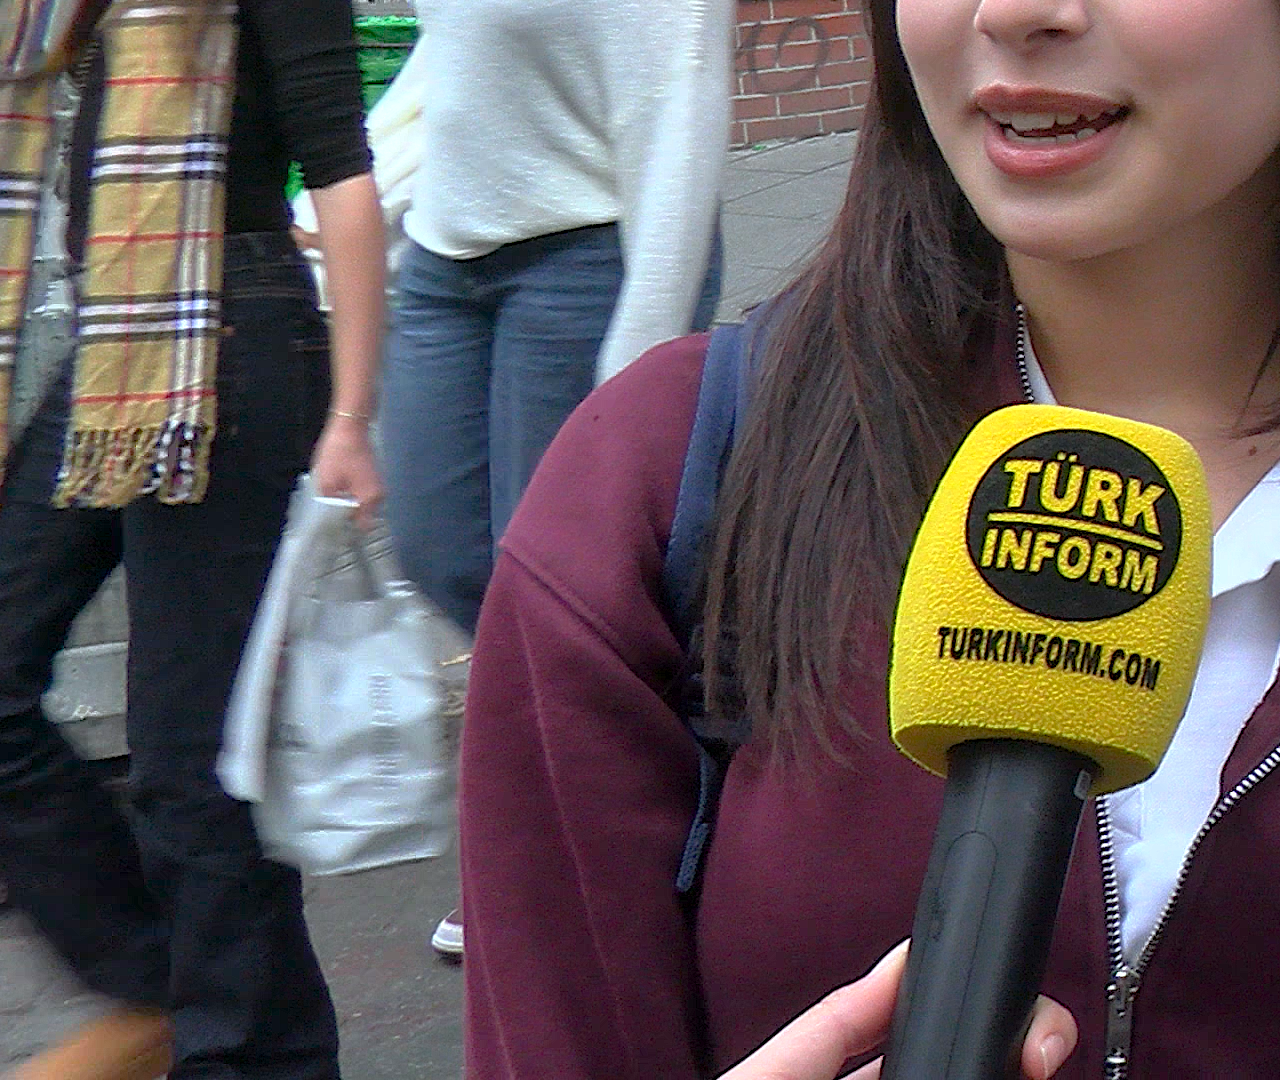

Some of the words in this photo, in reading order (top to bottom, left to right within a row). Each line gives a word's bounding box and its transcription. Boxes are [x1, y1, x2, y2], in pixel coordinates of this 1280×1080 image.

[1004, 451, 1166, 536] TÜRK
[980, 528, 1161, 596] INFORM
[937, 626, 1161, 692] TURKINFORM.COM
